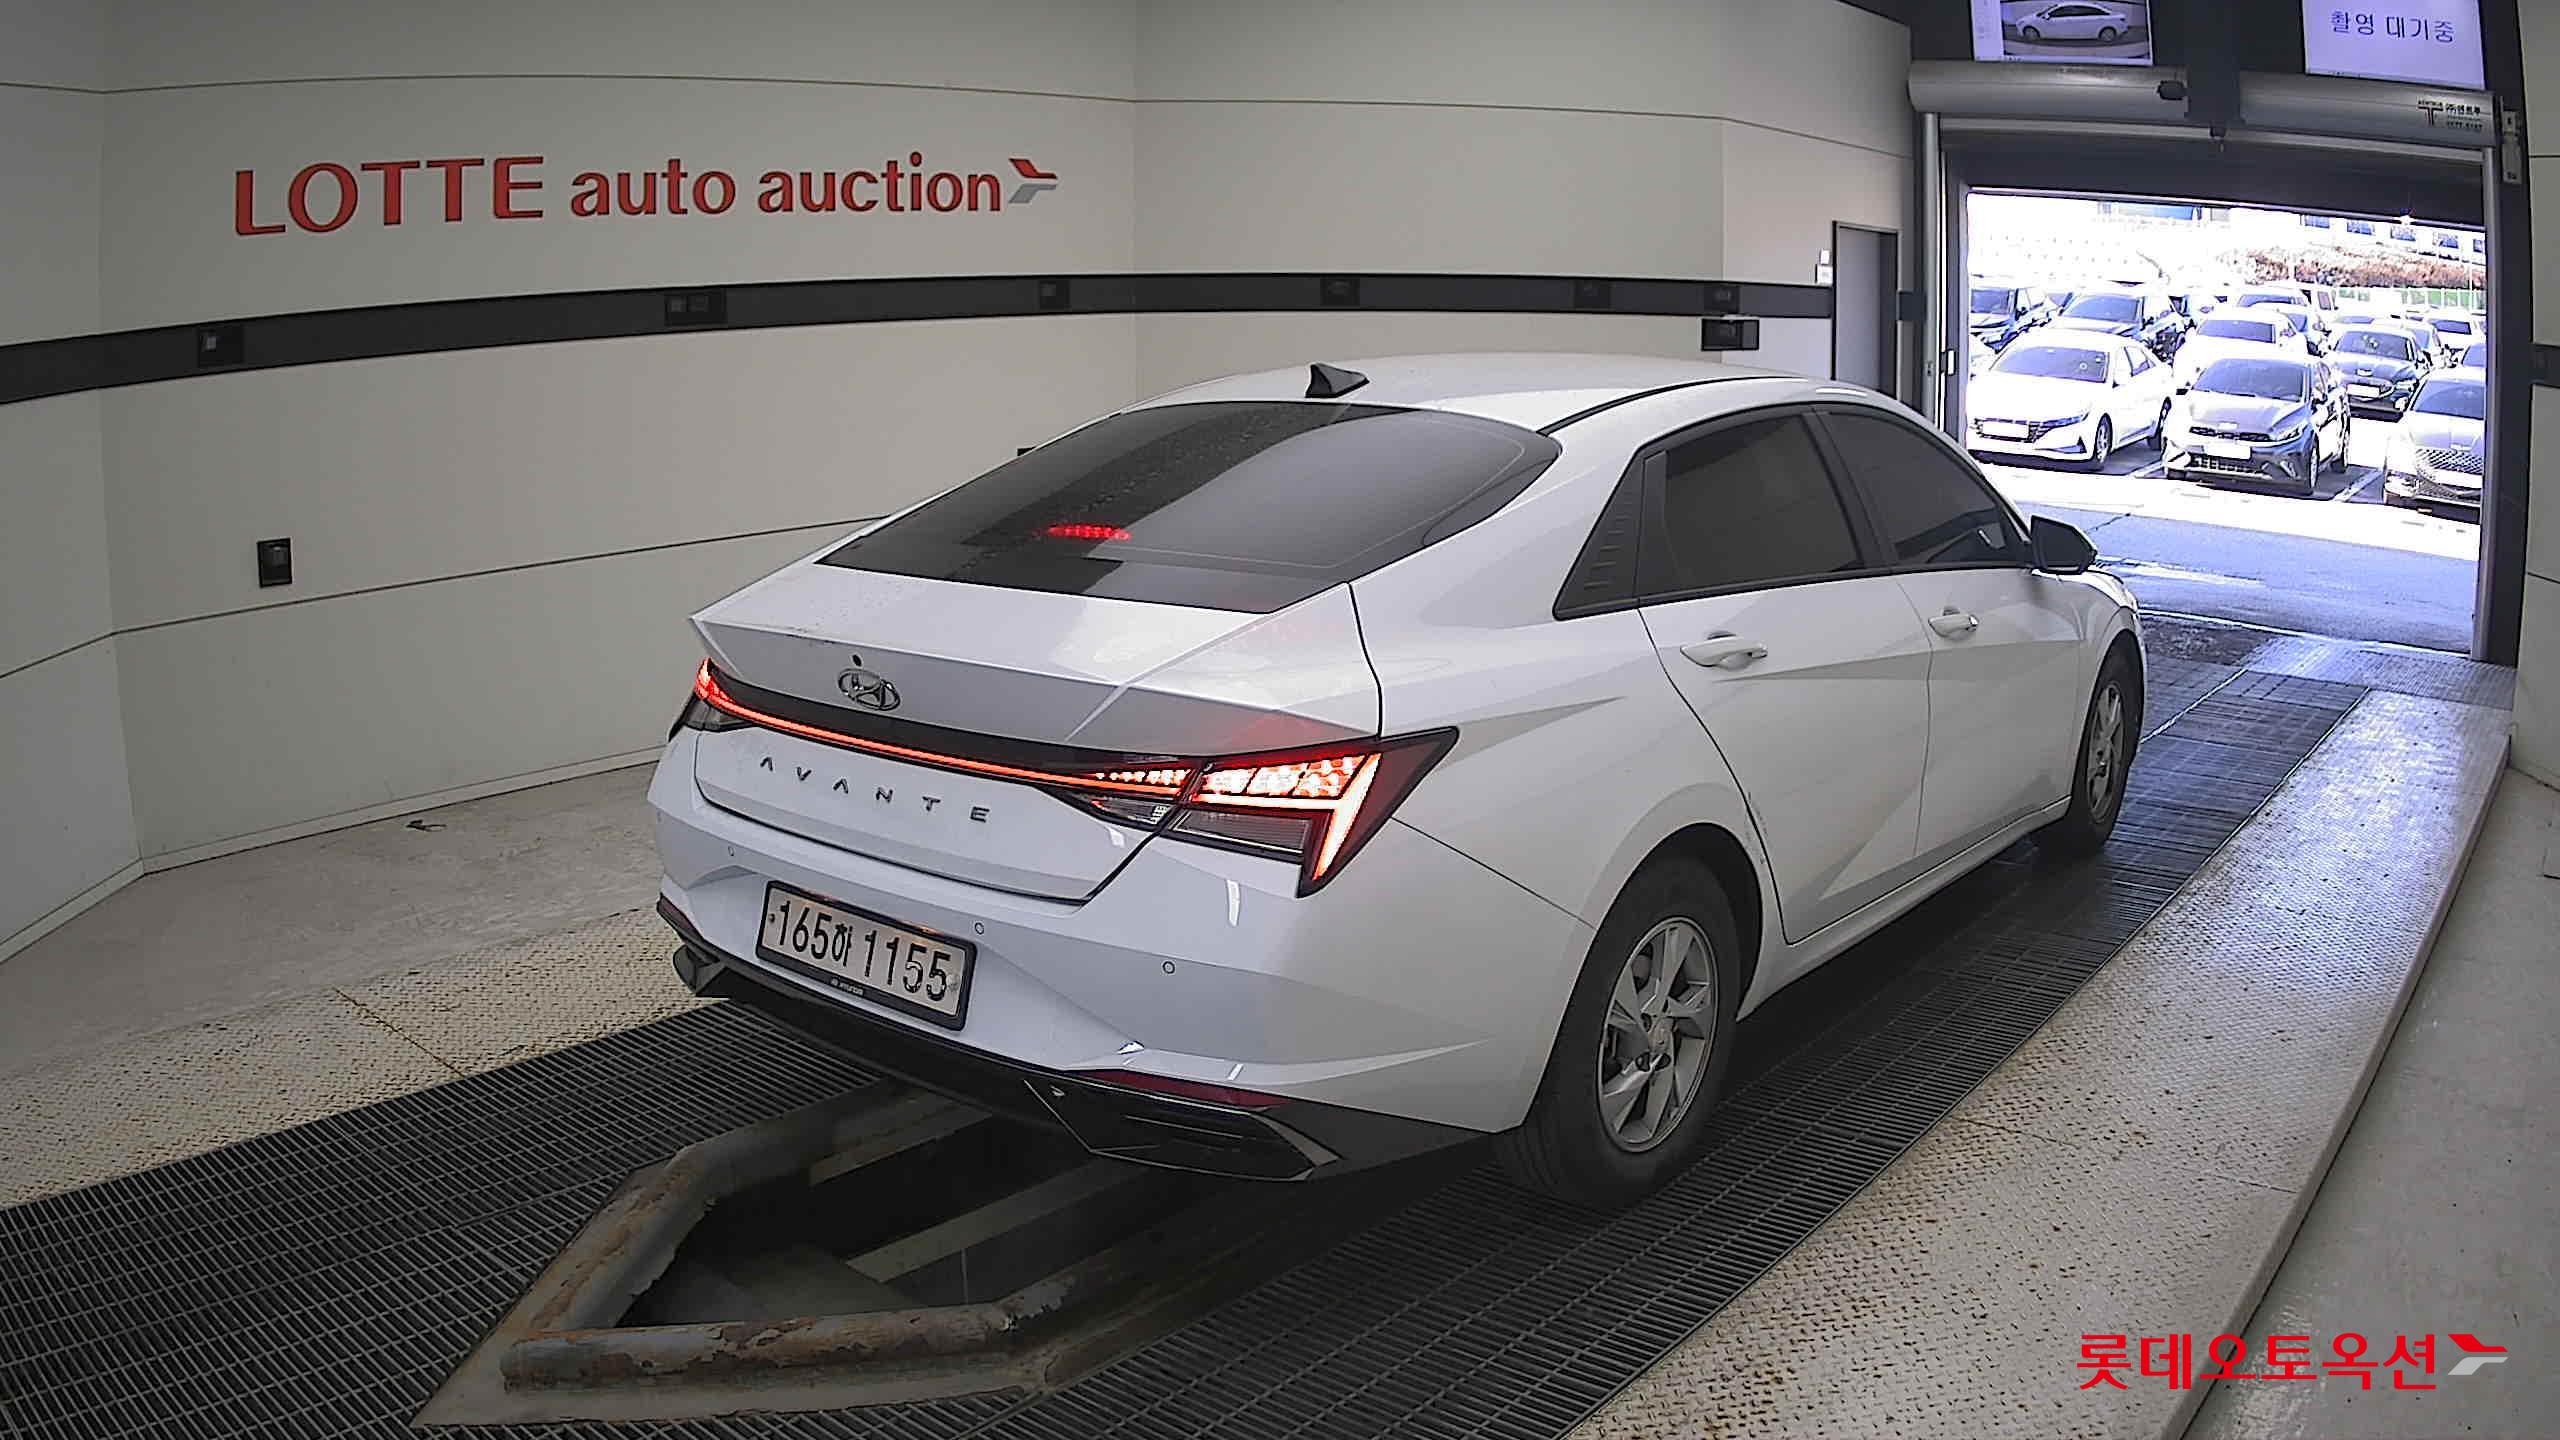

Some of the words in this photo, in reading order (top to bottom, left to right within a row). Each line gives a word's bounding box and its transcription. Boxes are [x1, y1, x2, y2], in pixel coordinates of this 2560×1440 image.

[2385, 16, 2455, 43] 대기중
[235, 156, 544, 235] LOTTE
[570, 158, 736, 217] auto
[758, 152, 1001, 213] auction
[760, 756, 990, 822] AVANTE
